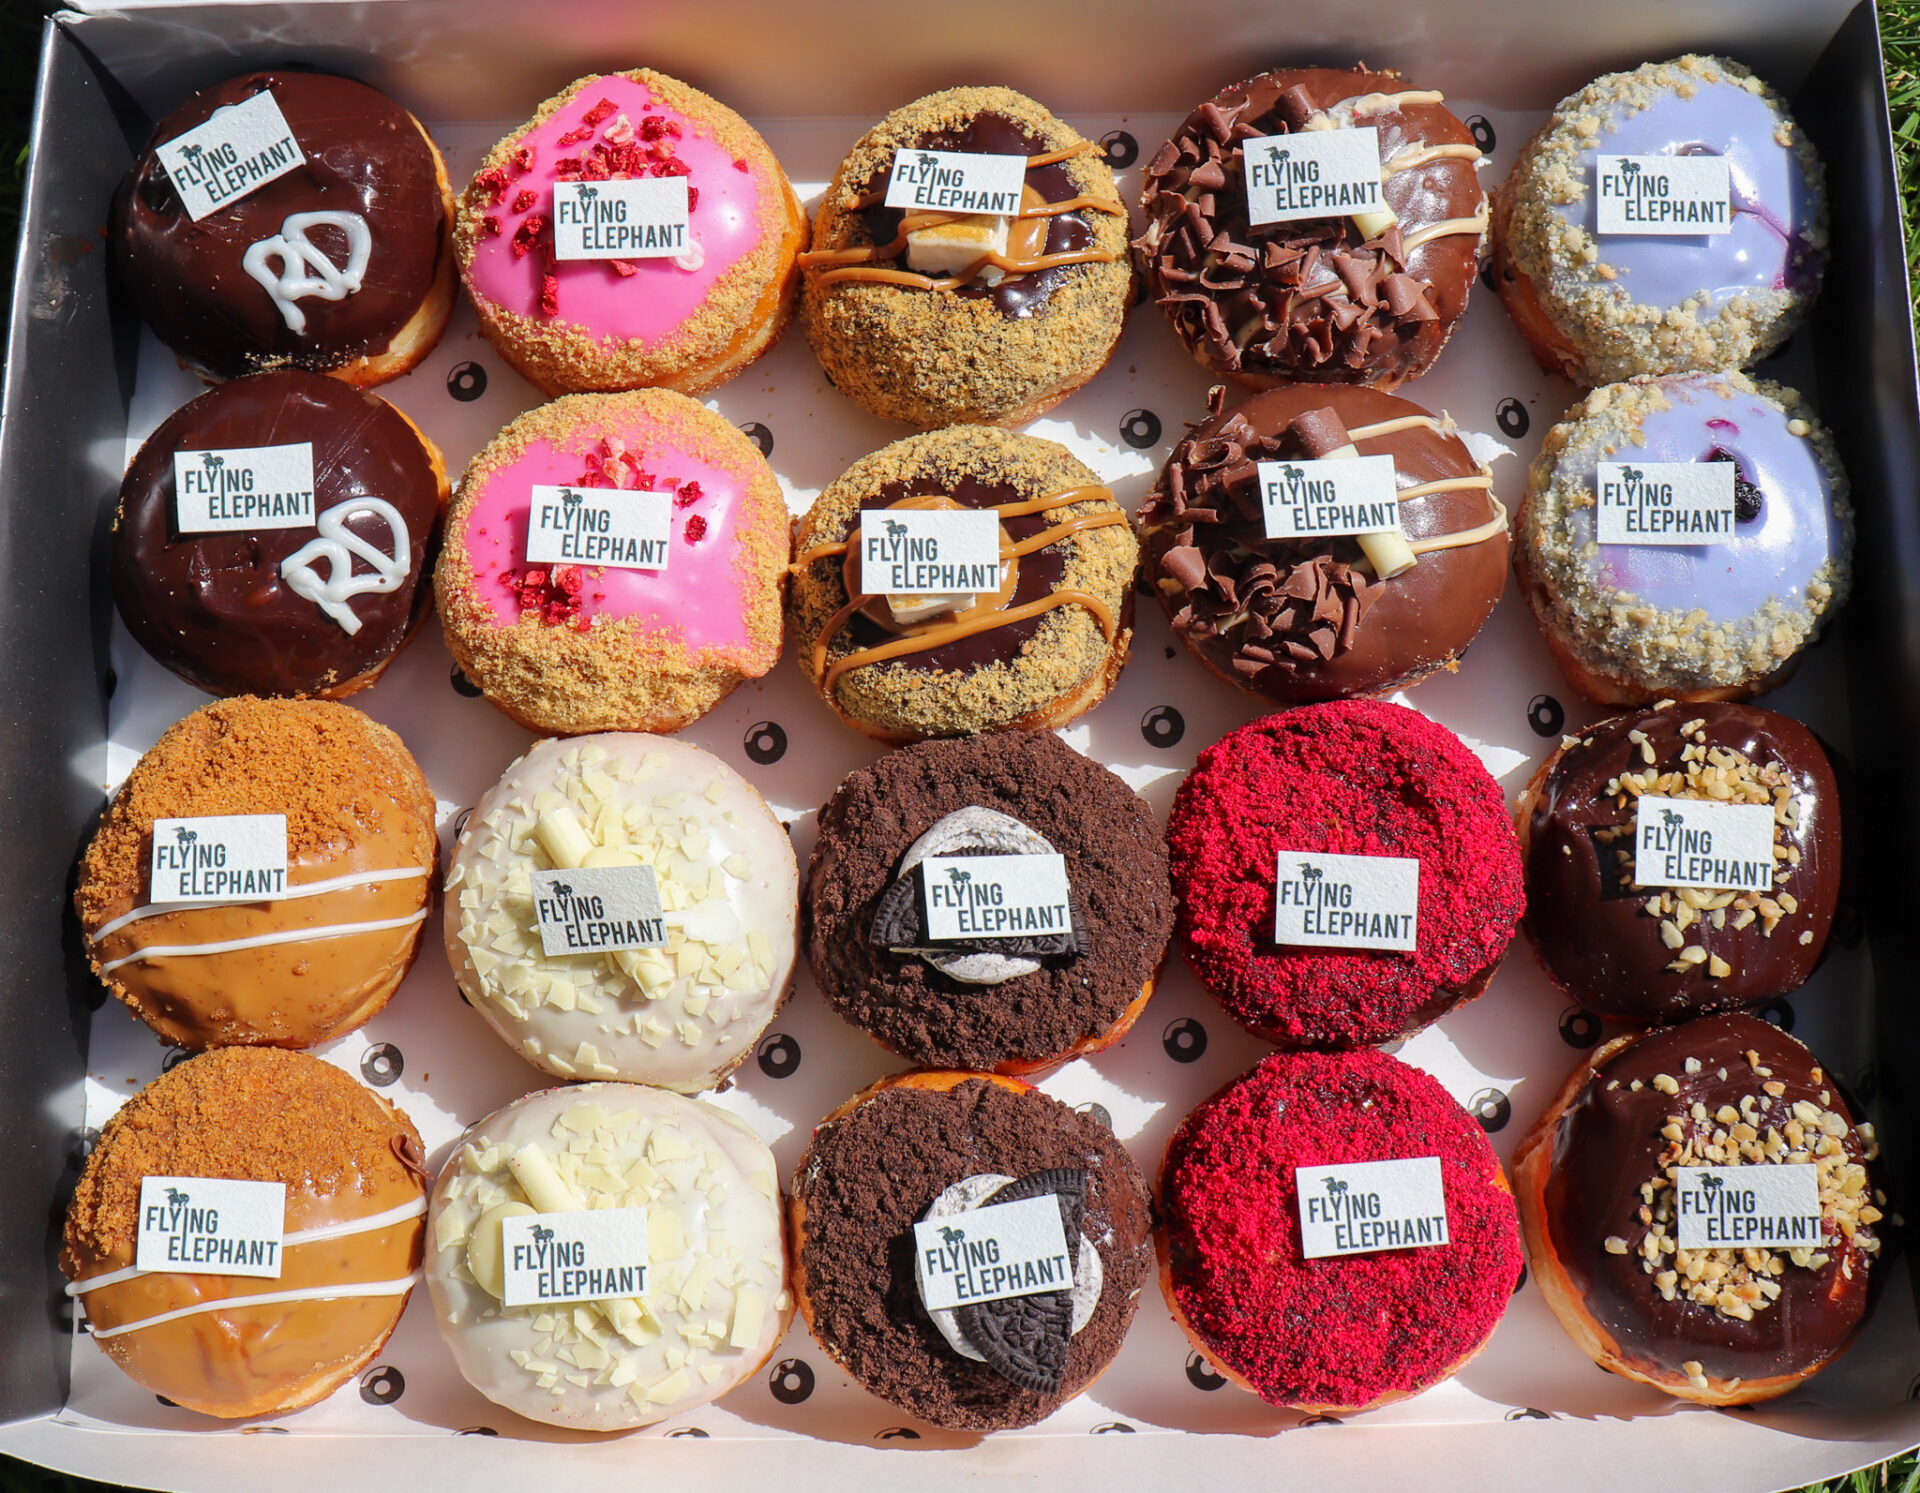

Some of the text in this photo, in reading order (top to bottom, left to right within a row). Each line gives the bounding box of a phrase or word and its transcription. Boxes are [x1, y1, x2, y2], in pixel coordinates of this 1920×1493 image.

[173, 143, 238, 191] FLYING
[204, 137, 297, 204] ELEPHANT
[896, 165, 964, 187] FLYING
[1252, 160, 1319, 187] FLYING
[915, 187, 1019, 211] ELEPHANT
[1276, 181, 1378, 210] ELEPHANT
[1602, 175, 1669, 197] FLYING
[560, 200, 626, 224] FLYING
[1625, 200, 1726, 223] ELEPHANT
[582, 224, 685, 249] ELEPHANT
[185, 468, 253, 493] FLYING
[1267, 480, 1336, 505] FLYING
[208, 492, 312, 519] ELEPHANT
[1603, 483, 1672, 506] FLYING
[541, 505, 610, 532] FLYING
[1292, 502, 1396, 531] ELEPHANT
[1626, 510, 1731, 532] ELEPHANT
[561, 534, 667, 564] ELEPHANT
[868, 537, 937, 562] FLYING
[891, 565, 997, 589] ELEPHANT
[1643, 826, 1712, 854] FLYING
[157, 844, 226, 869] FLYING
[179, 868, 284, 896] ELEPHANT
[1665, 855, 1771, 887] ELEPHANT
[931, 883, 1002, 908] FLYING
[1281, 880, 1352, 908] FLYING
[539, 896, 605, 923] FLYING
[957, 905, 1065, 932] ELEPHANT
[565, 918, 663, 948] ELEPHANT
[1303, 909, 1412, 939] ELEPHANT
[1308, 1193, 1380, 1223] FLYING
[1681, 1190, 1755, 1214] FLYING
[146, 1206, 218, 1233] FLYING
[1335, 1216, 1444, 1249] ELEPHANT
[1707, 1216, 1819, 1240] ELEPHANT
[168, 1236, 278, 1266] ELEPHANT
[513, 1241, 584, 1270] FLYING
[925, 1238, 1000, 1275] FLYING
[538, 1266, 646, 1298] ELEPHANT
[955, 1255, 1065, 1299] ELEPHANT
